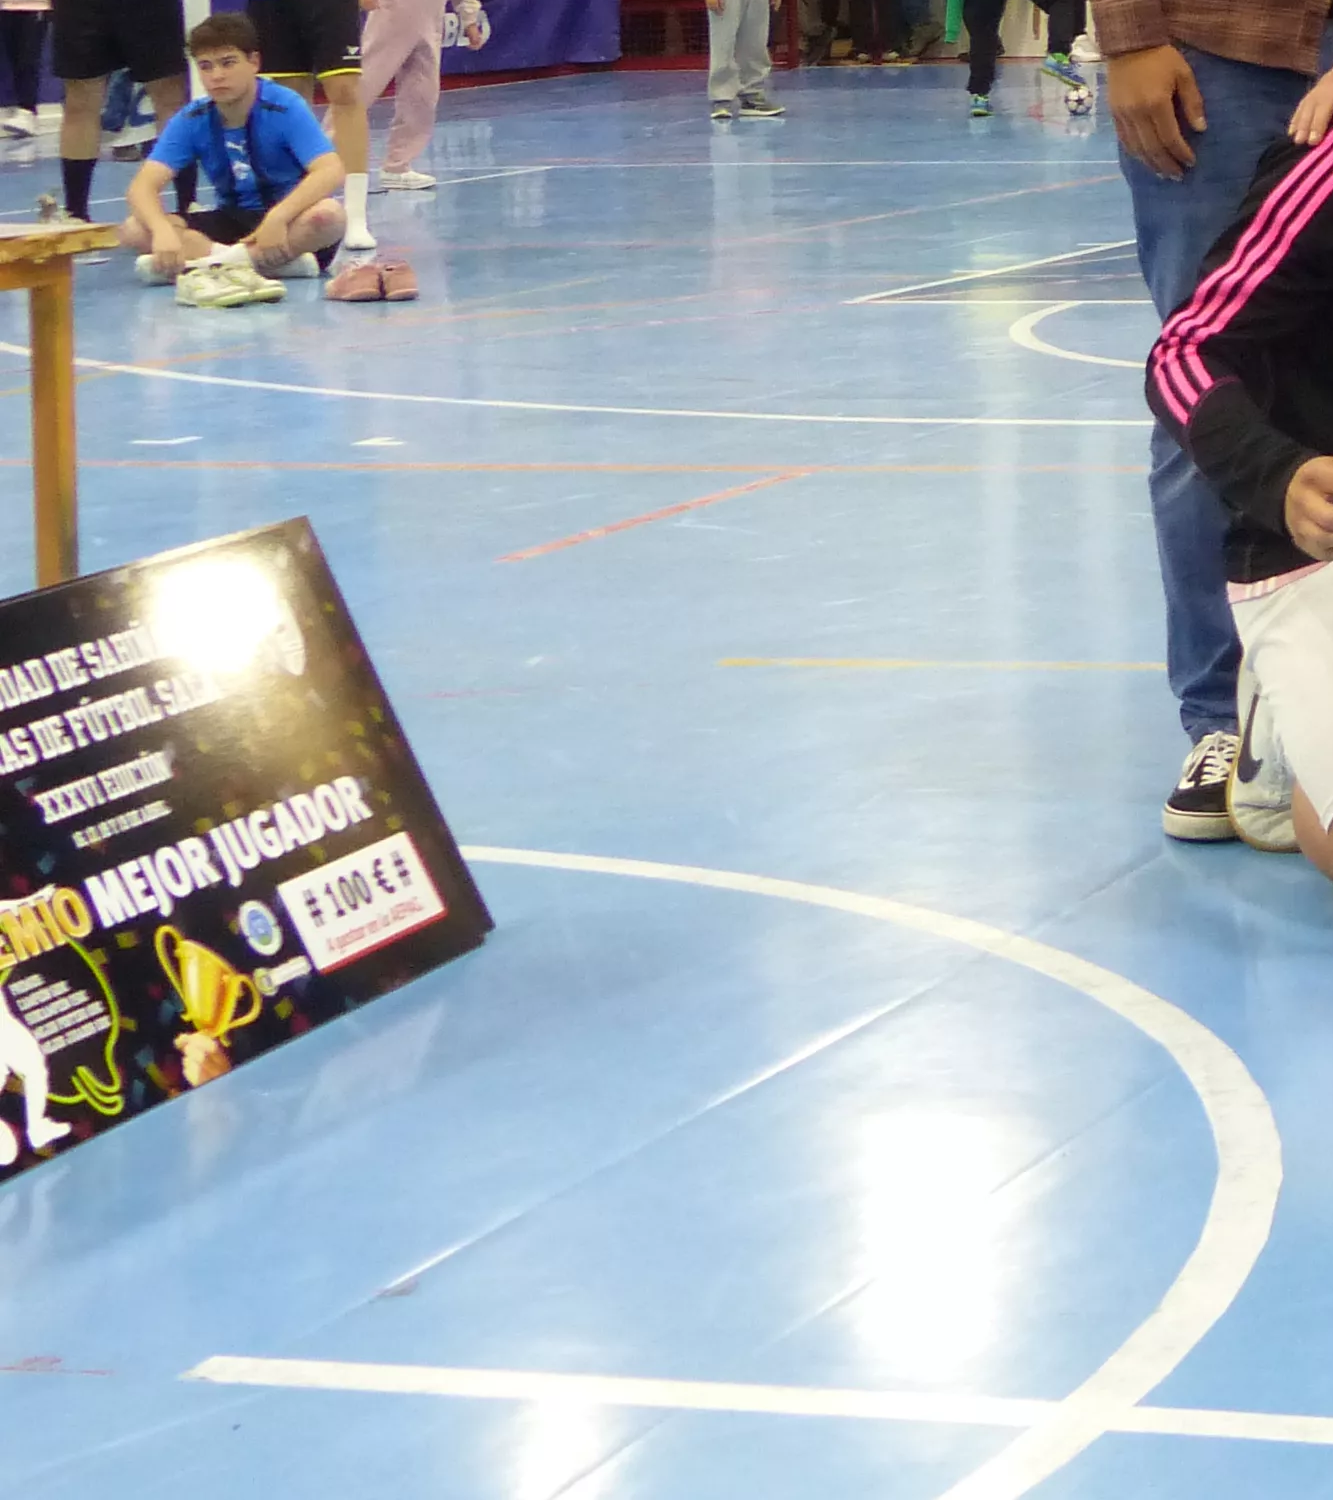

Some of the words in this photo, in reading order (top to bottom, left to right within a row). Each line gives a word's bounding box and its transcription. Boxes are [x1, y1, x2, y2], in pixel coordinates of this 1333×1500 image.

[84, 836, 223, 930] MEJOR
[207, 775, 374, 889] JUGADOR
[325, 869, 373, 918] 100
[372, 857, 397, 894] €
